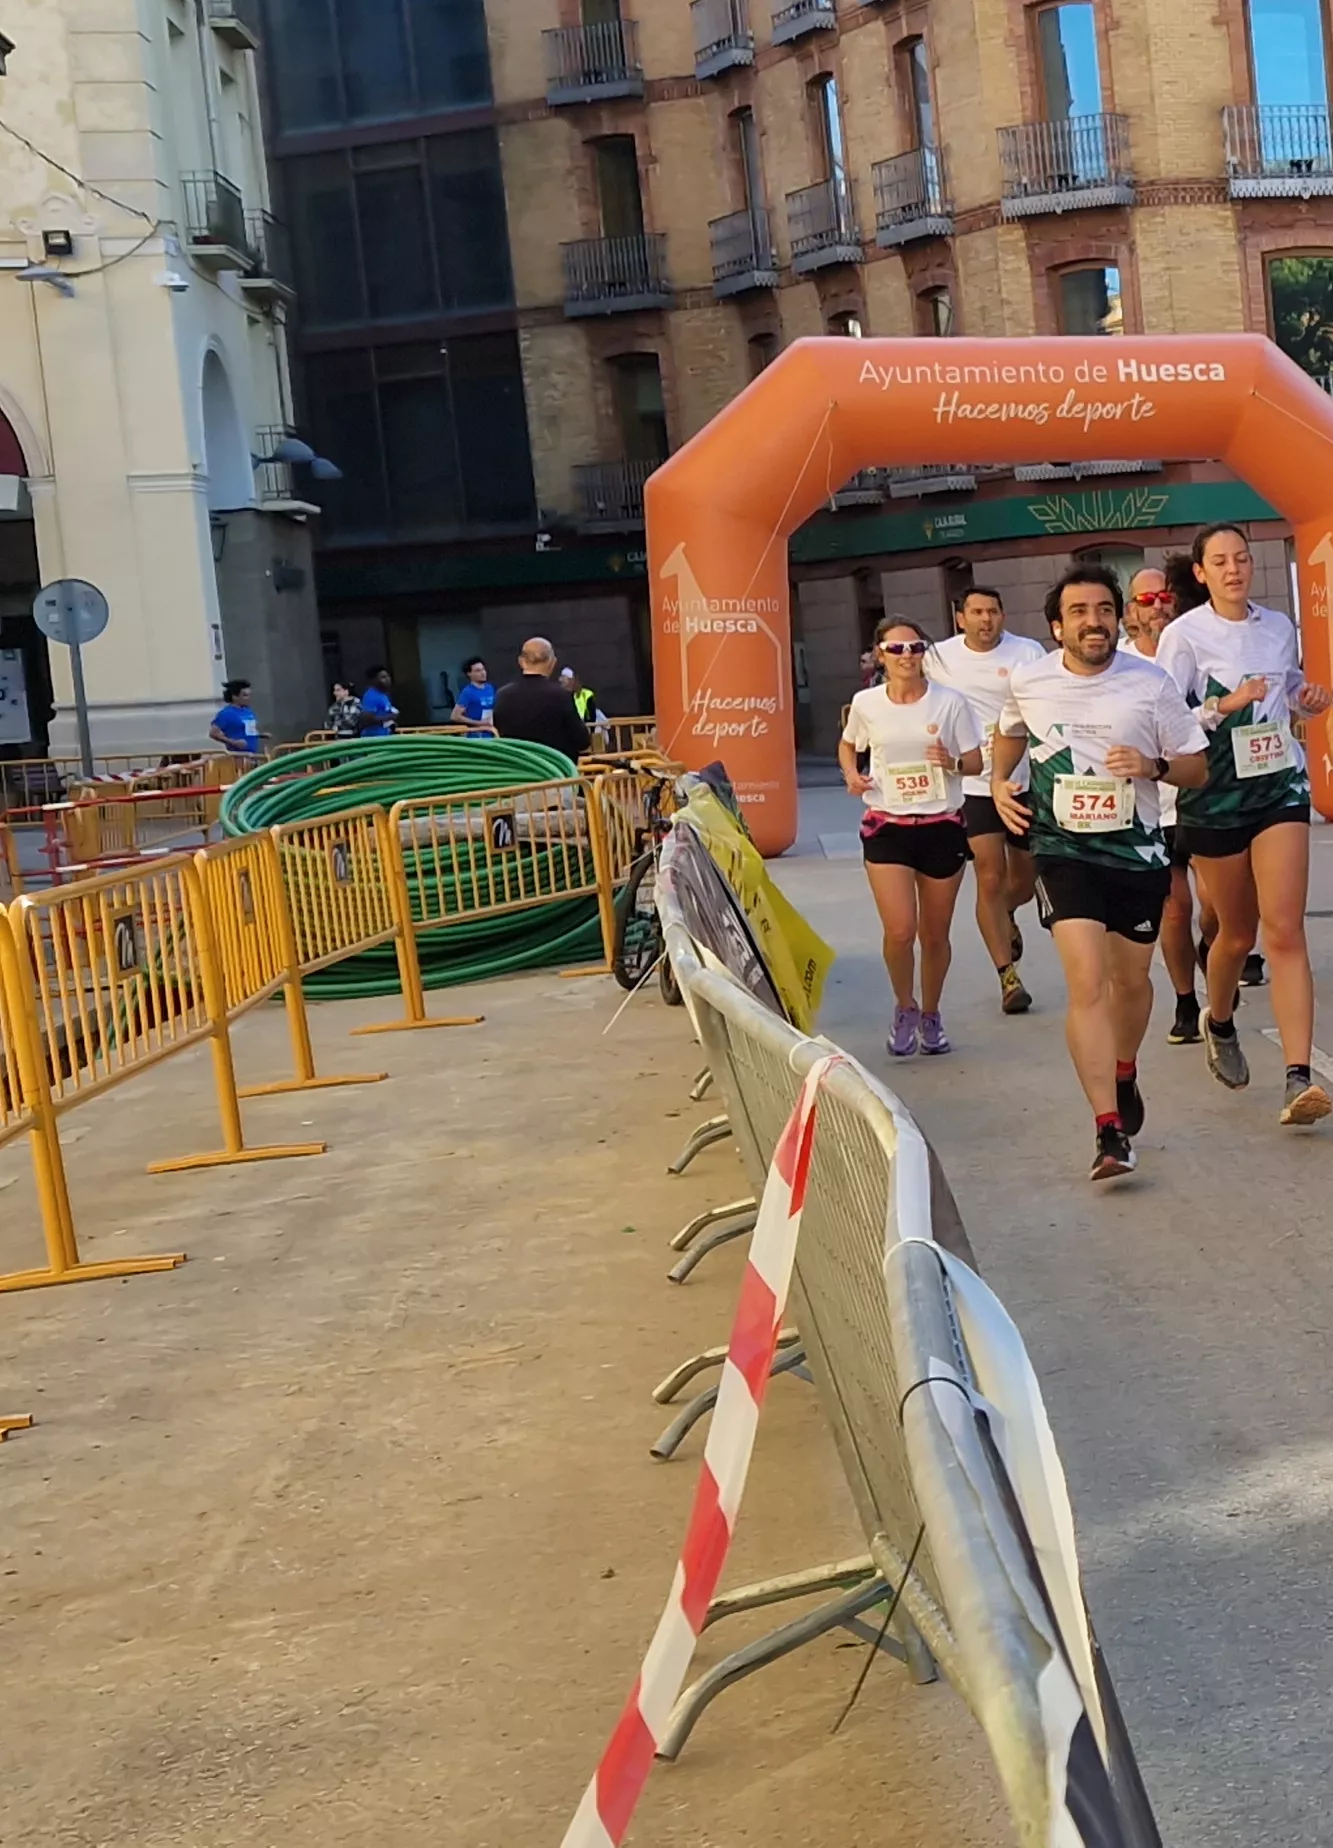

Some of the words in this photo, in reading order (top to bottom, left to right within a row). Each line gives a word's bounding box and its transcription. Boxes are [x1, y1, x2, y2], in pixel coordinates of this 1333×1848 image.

[859, 359, 1065, 390] Ayuntamiento
[1074, 360, 1108, 383] de
[1116, 358, 1226, 383] Huesca
[933, 391, 1050, 426] Hacemos
[1056, 388, 1157, 432] deporte
[662, 595, 780, 616] Ayuntamiento
[1312, 602, 1328, 617] de
[663, 619, 680, 634] de
[685, 616, 757, 634] Huesca
[688, 688, 777, 714] Hacemos
[691, 712, 769, 748] deporte
[1249, 734, 1283, 754] 573
[896, 775, 930, 790] 538
[1071, 794, 1117, 811] 574
[1070, 812, 1118, 821] MARIANO
